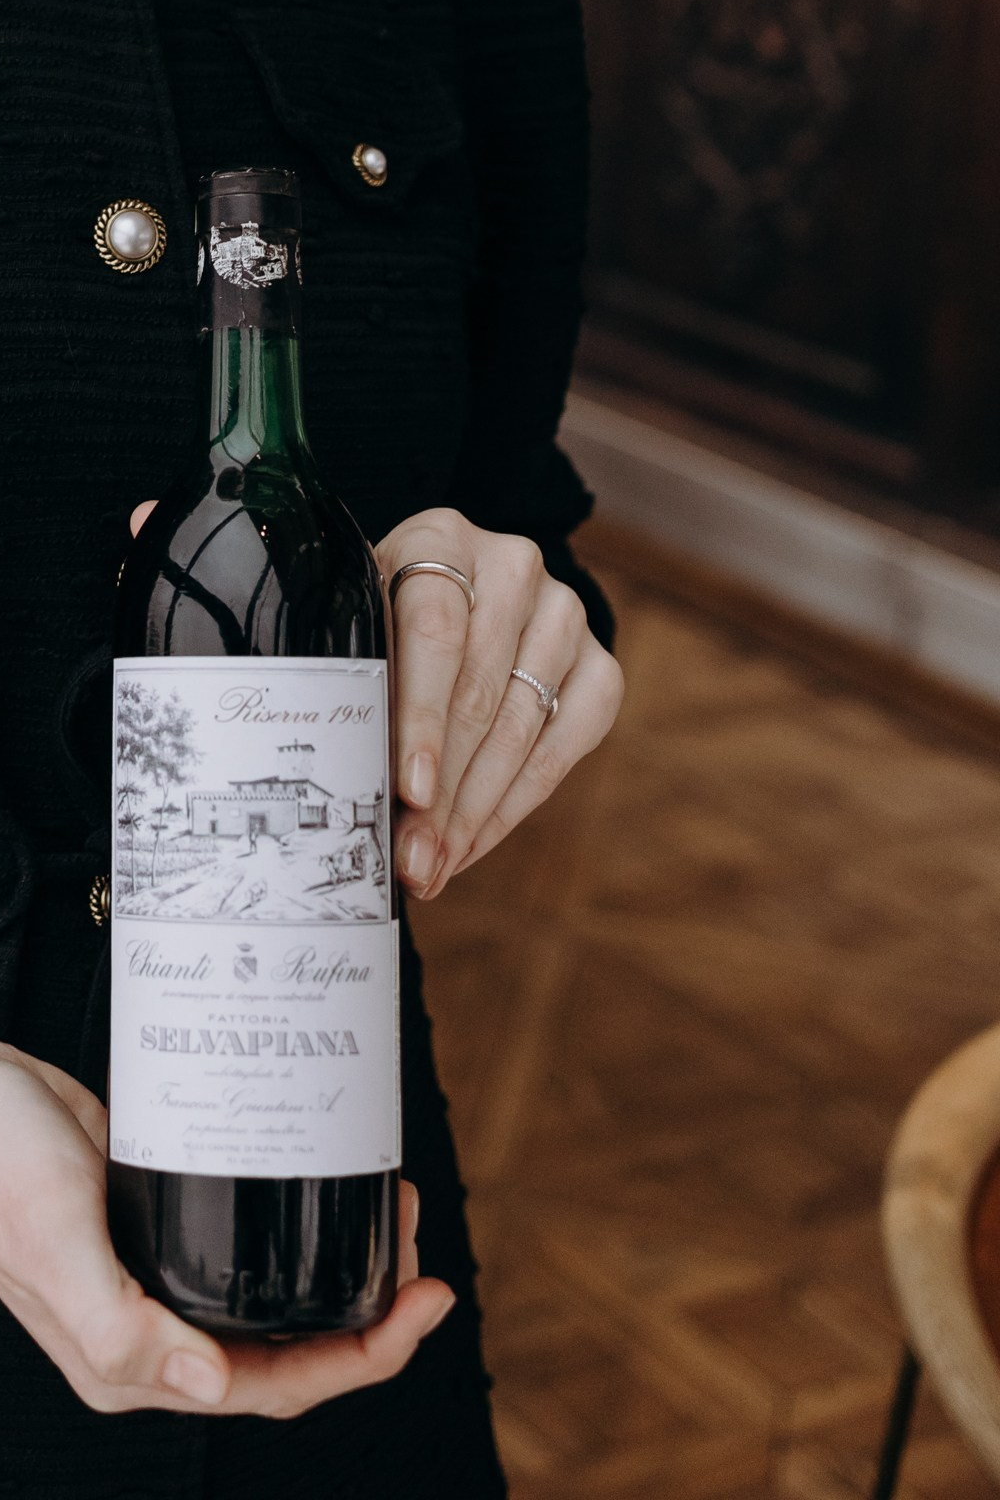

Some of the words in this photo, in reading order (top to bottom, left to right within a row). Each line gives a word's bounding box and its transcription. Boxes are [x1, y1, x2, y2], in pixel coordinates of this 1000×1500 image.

[214, 686, 320, 725] Riserva
[327, 704, 375, 725] 1980
[126, 940, 212, 982] Chianti
[271, 944, 373, 990] Rufina
[208, 1013, 290, 1025] FATTORIA
[140, 1024, 360, 1057] SELVAPIANA
